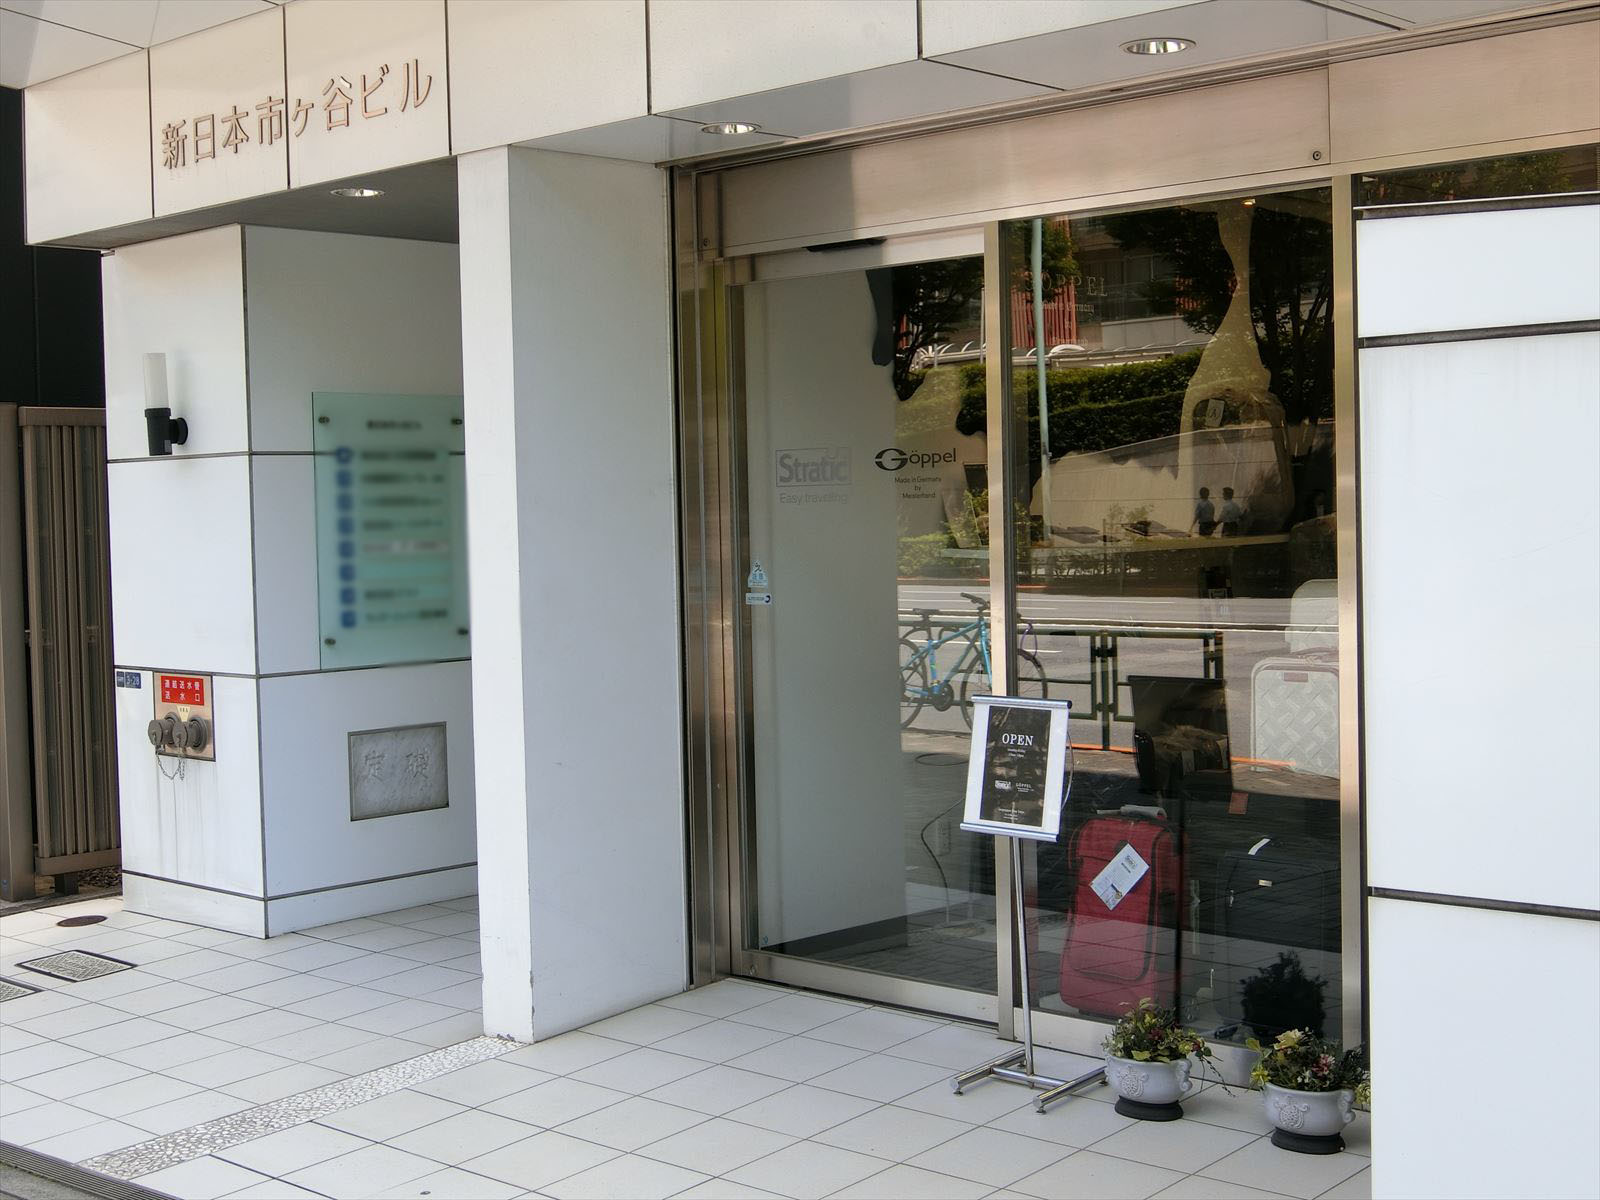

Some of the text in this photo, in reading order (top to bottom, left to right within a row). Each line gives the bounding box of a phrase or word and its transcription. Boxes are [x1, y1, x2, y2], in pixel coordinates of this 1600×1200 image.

[874, 448, 957, 471] Göppel
[779, 450, 848, 483] Stratic
[894, 476, 910, 484] Made
[916, 475, 942, 485] Germany
[779, 493, 801, 505] Easy
[1002, 733, 1034, 746] OPEN
